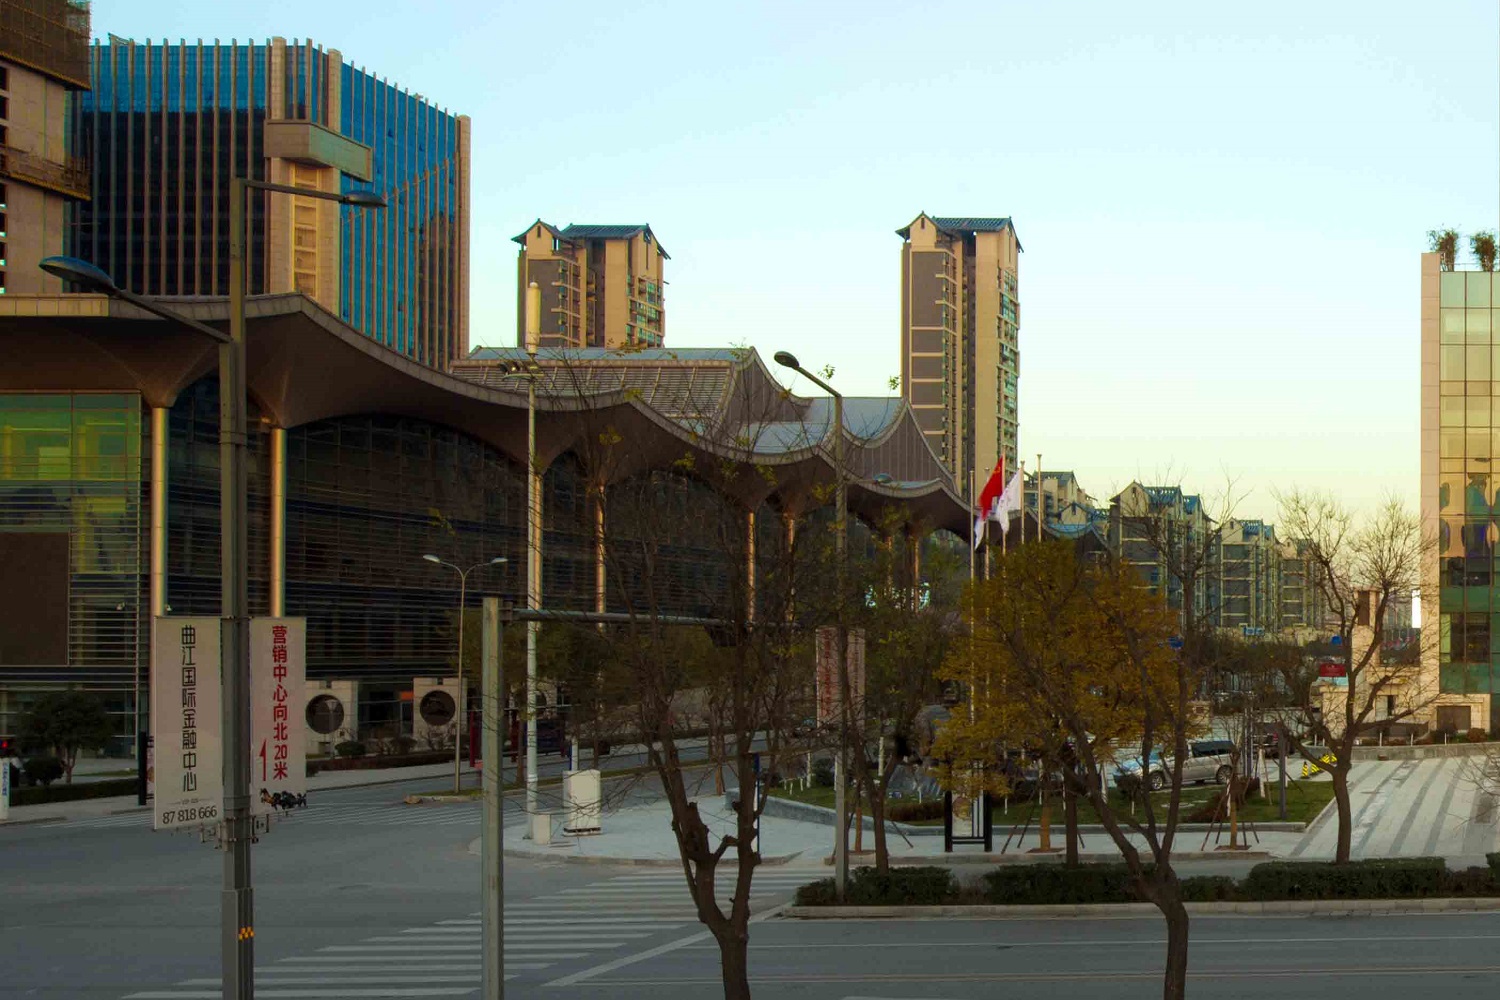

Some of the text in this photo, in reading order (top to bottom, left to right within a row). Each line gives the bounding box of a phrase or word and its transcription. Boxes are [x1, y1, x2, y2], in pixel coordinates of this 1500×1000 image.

[181, 624, 197, 792] 曲江国际金融中心
[162, 805, 217, 825] 87 818 666
